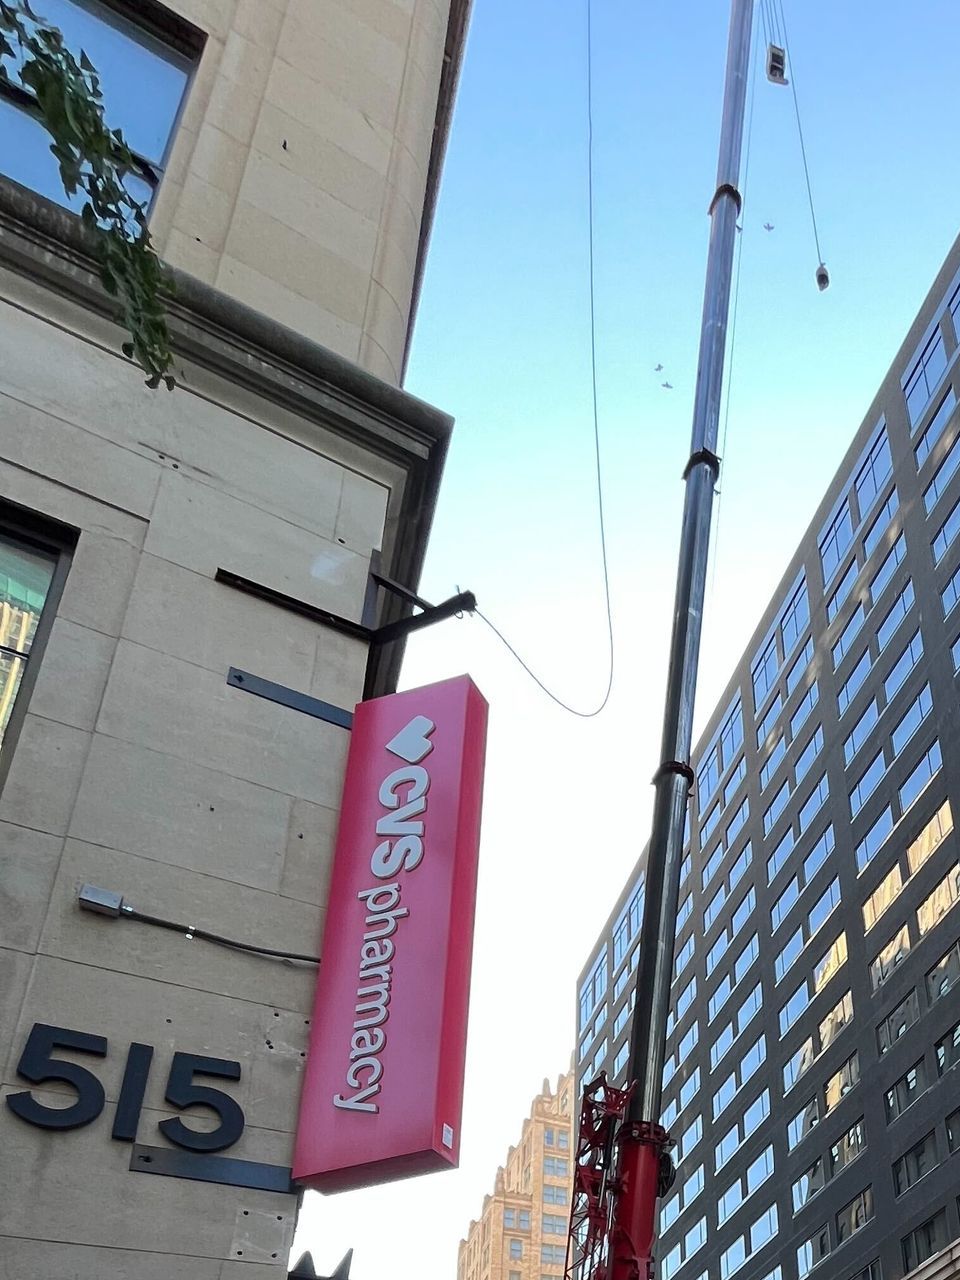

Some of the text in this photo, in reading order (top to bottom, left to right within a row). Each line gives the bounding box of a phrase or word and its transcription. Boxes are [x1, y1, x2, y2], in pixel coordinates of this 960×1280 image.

[333, 765, 431, 1113] CVS pharmacy
[5, 1022, 246, 1154] 515
